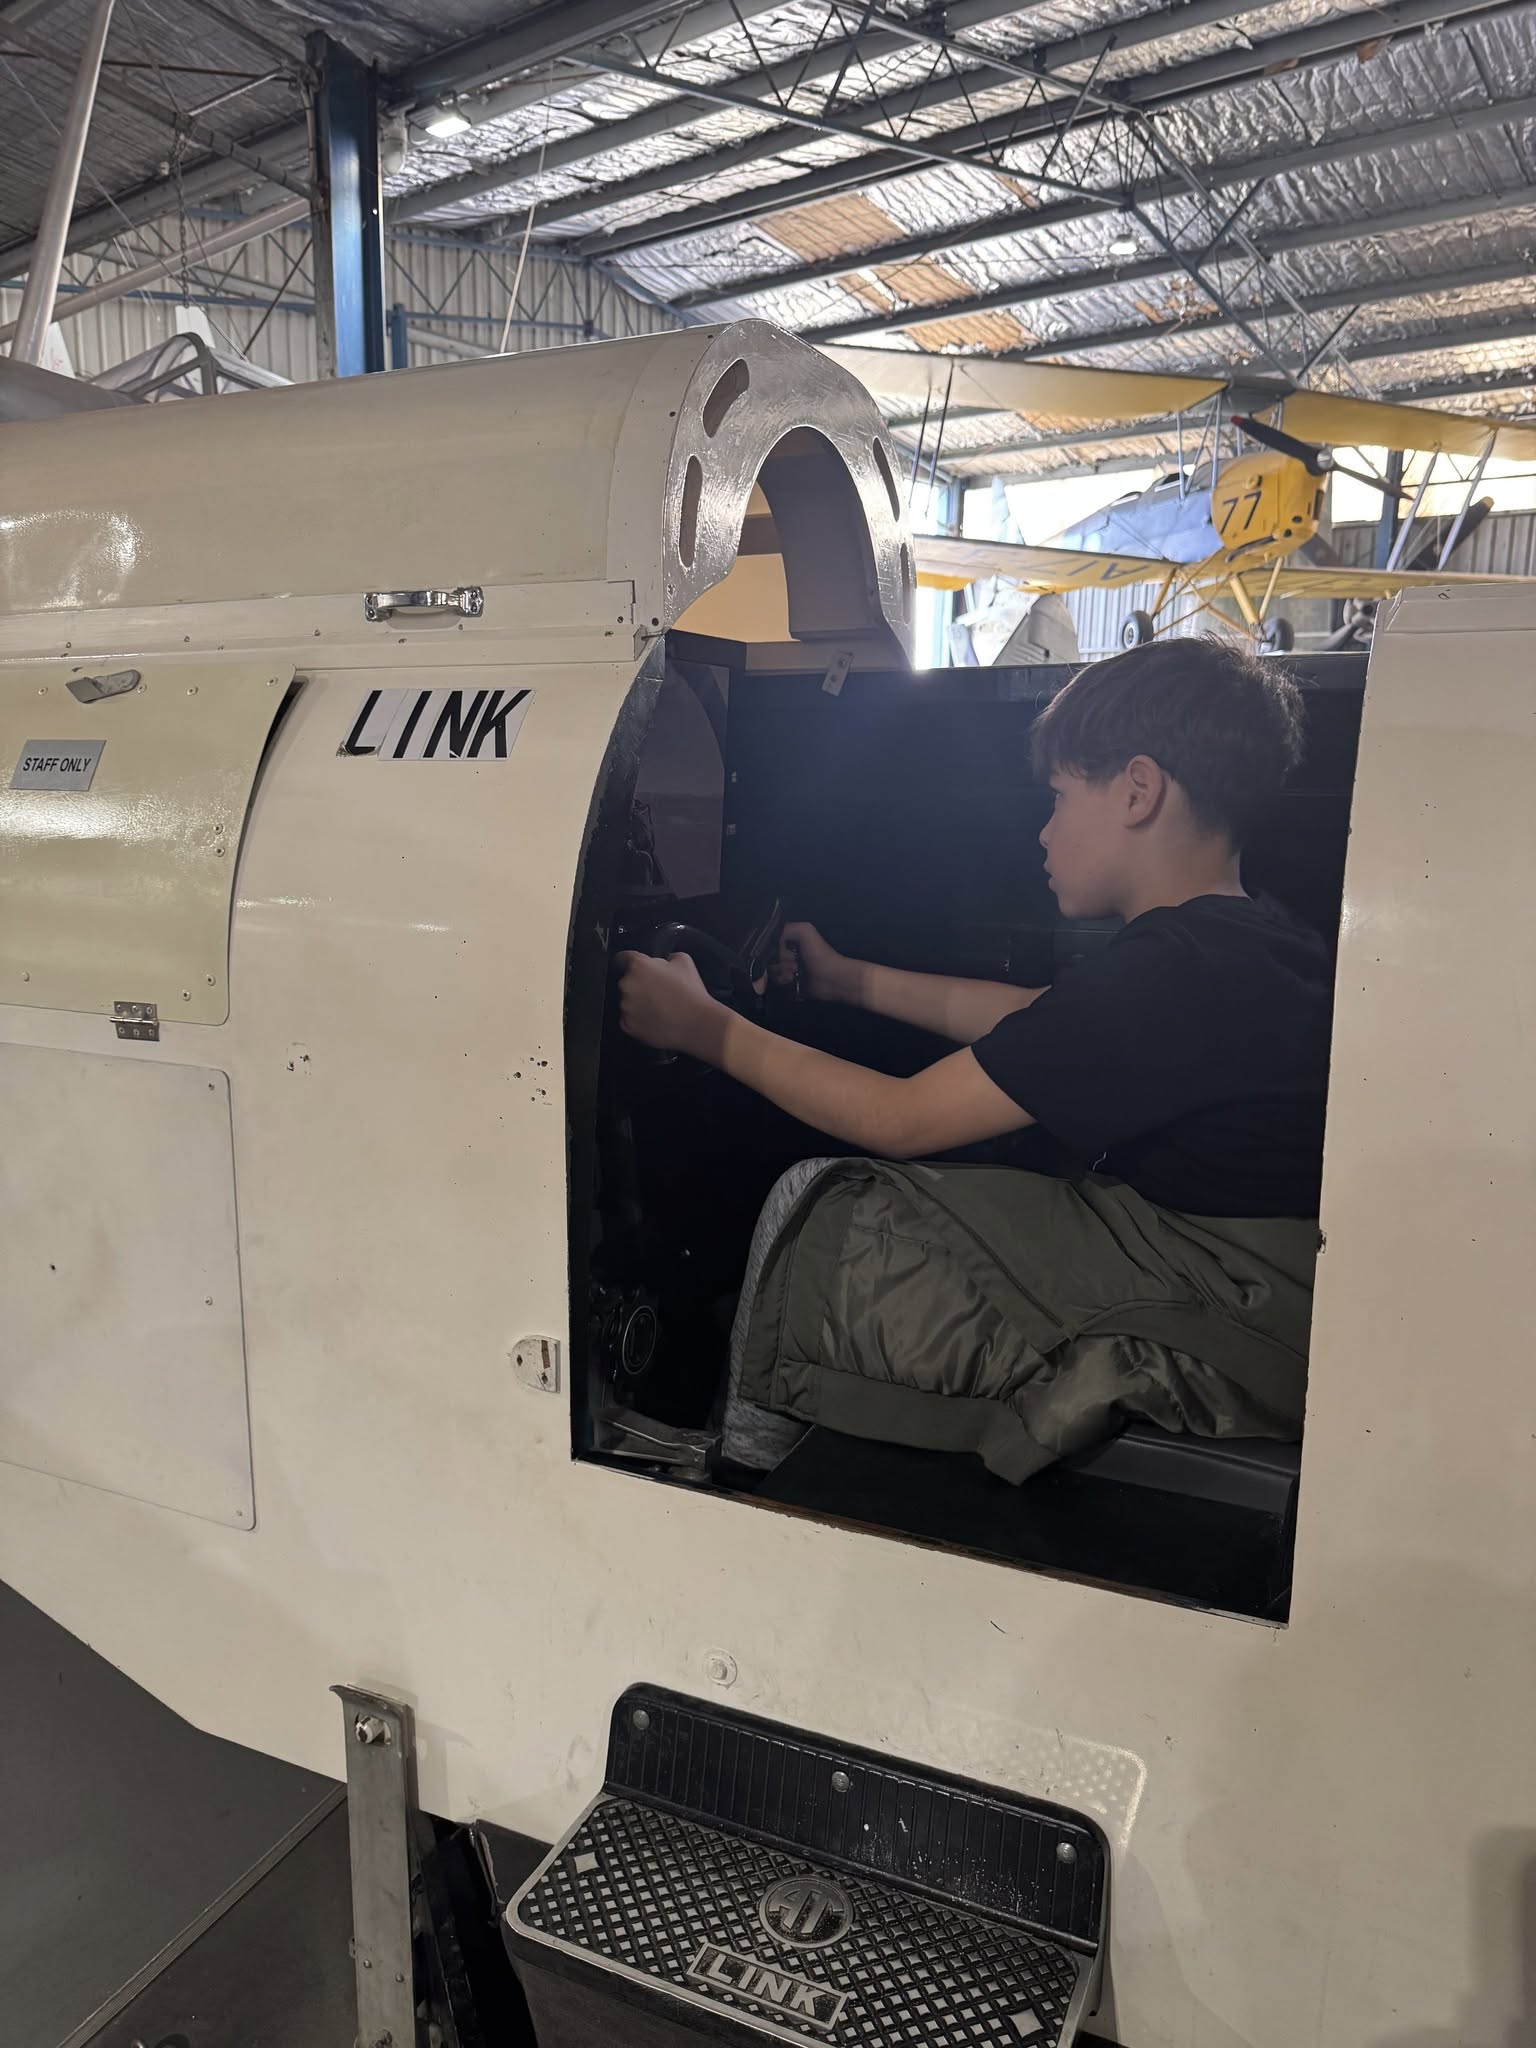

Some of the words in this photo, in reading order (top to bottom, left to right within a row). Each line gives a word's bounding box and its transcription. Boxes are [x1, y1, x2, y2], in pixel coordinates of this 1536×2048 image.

[1220, 491, 1262, 535] 77
[342, 689, 532, 758] LINK
[22, 757, 60, 772] STAFF
[60, 757, 91, 772] ONLY
[707, 1953, 827, 2016] LINK
